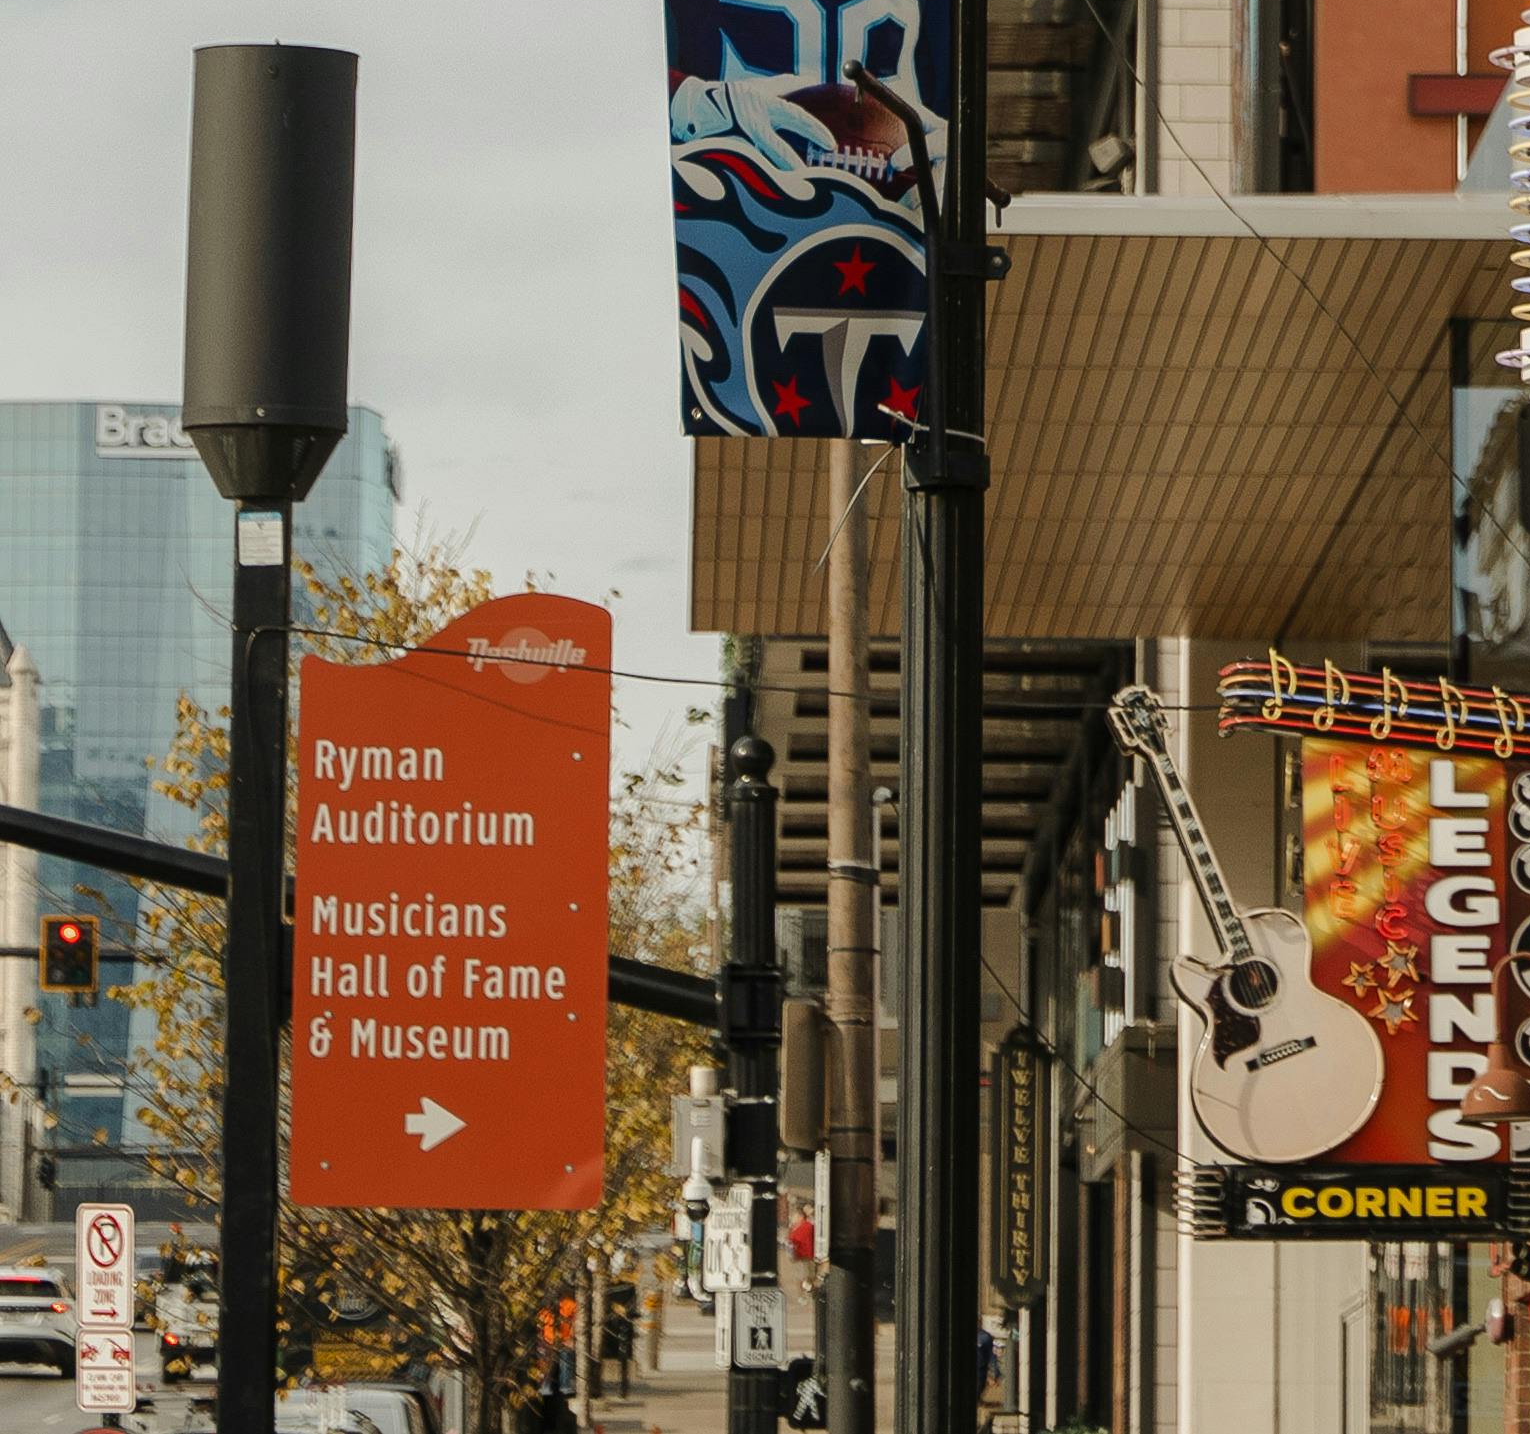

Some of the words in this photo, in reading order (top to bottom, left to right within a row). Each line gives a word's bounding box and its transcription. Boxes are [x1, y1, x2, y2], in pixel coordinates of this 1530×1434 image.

[314, 739, 445, 792] Ryman
[310, 800, 535, 847] Auditorium
[311, 891, 508, 938] Musicians
[310, 953, 390, 998] Hall
[406, 954, 447, 999] of
[463, 957, 567, 1001] Fame
[1424, 759, 1502, 1162] LEGENDS
[308, 1015, 333, 1059] &
[350, 1016, 511, 1061] Museum
[1011, 1050, 1032, 1164] TWELVE
[1281, 1185, 1488, 1220] CORNER
[1011, 1172, 1032, 1287] THIRTY
